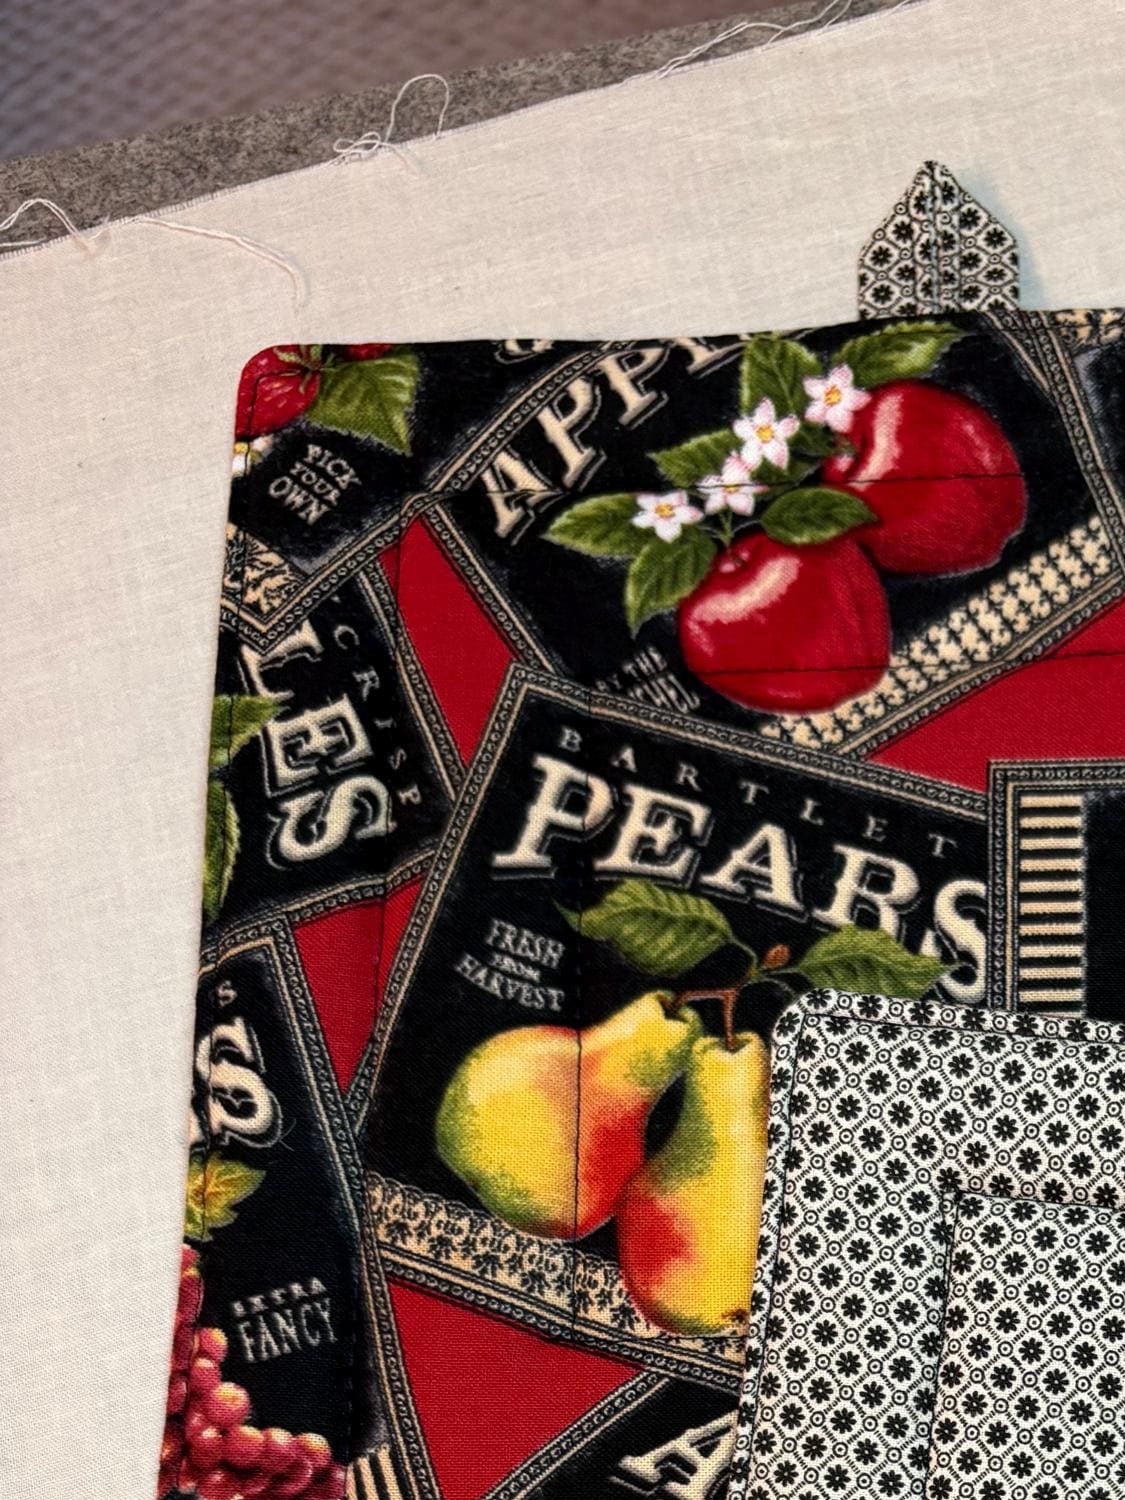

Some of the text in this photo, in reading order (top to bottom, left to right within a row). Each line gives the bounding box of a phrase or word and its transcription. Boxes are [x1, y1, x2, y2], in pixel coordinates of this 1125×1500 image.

[289, 461, 341, 506] YOUR
[303, 443, 362, 490] PICK
[268, 476, 330, 525] OWN
[558, 726, 959, 860] BARTLET
[490, 754, 988, 1006] PEARS
[486, 918, 566, 970] FRESH
[455, 951, 566, 1012] HARVEST
[238, 1298, 339, 1363] FANCY
